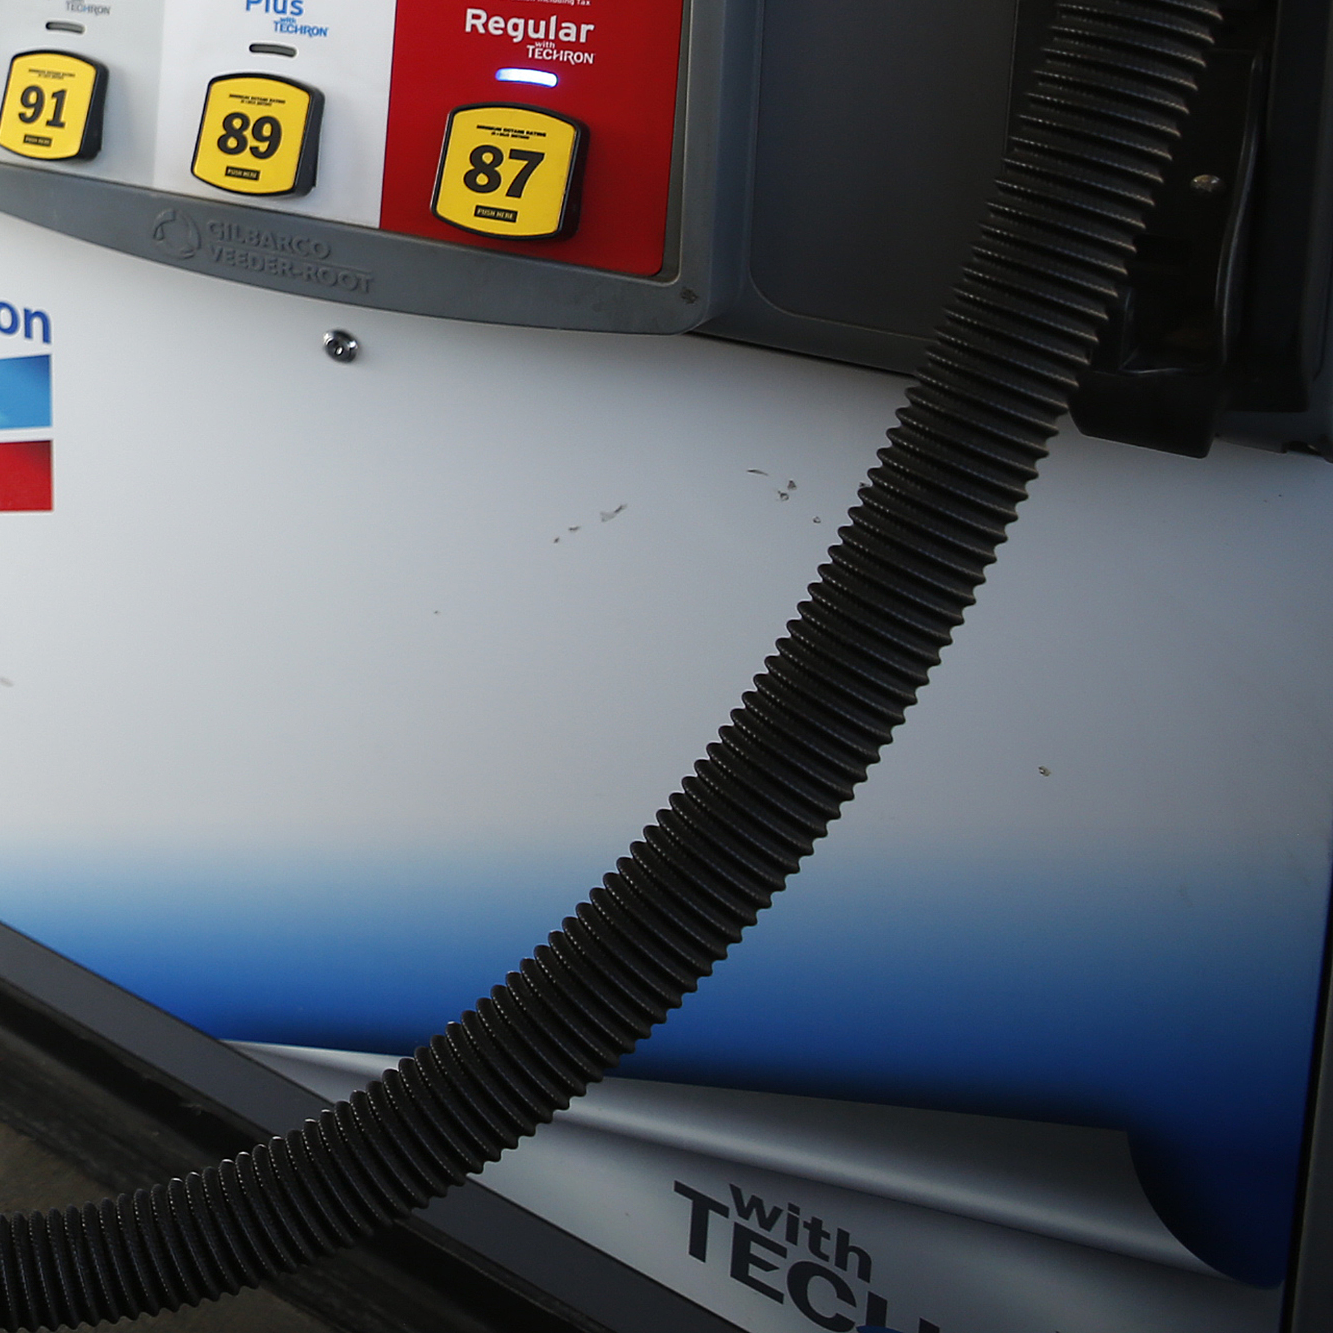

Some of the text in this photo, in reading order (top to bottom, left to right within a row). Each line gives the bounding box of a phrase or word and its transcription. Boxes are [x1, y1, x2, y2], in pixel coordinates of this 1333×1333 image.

[66, 0, 111, 16] TECHRON
[465, 8, 595, 43] Regular
[274, 21, 328, 37] TECHRON
[527, 45, 593, 65] TECHRON
[18, 85, 67, 129] 91
[217, 112, 282, 160] 89
[463, 144, 545, 199] 87
[496, 211, 513, 219] HERE
[206, 220, 332, 260] GILBARCO
[210, 244, 375, 294] VEEDER-ROOT
[728, 1183, 872, 1284] with
